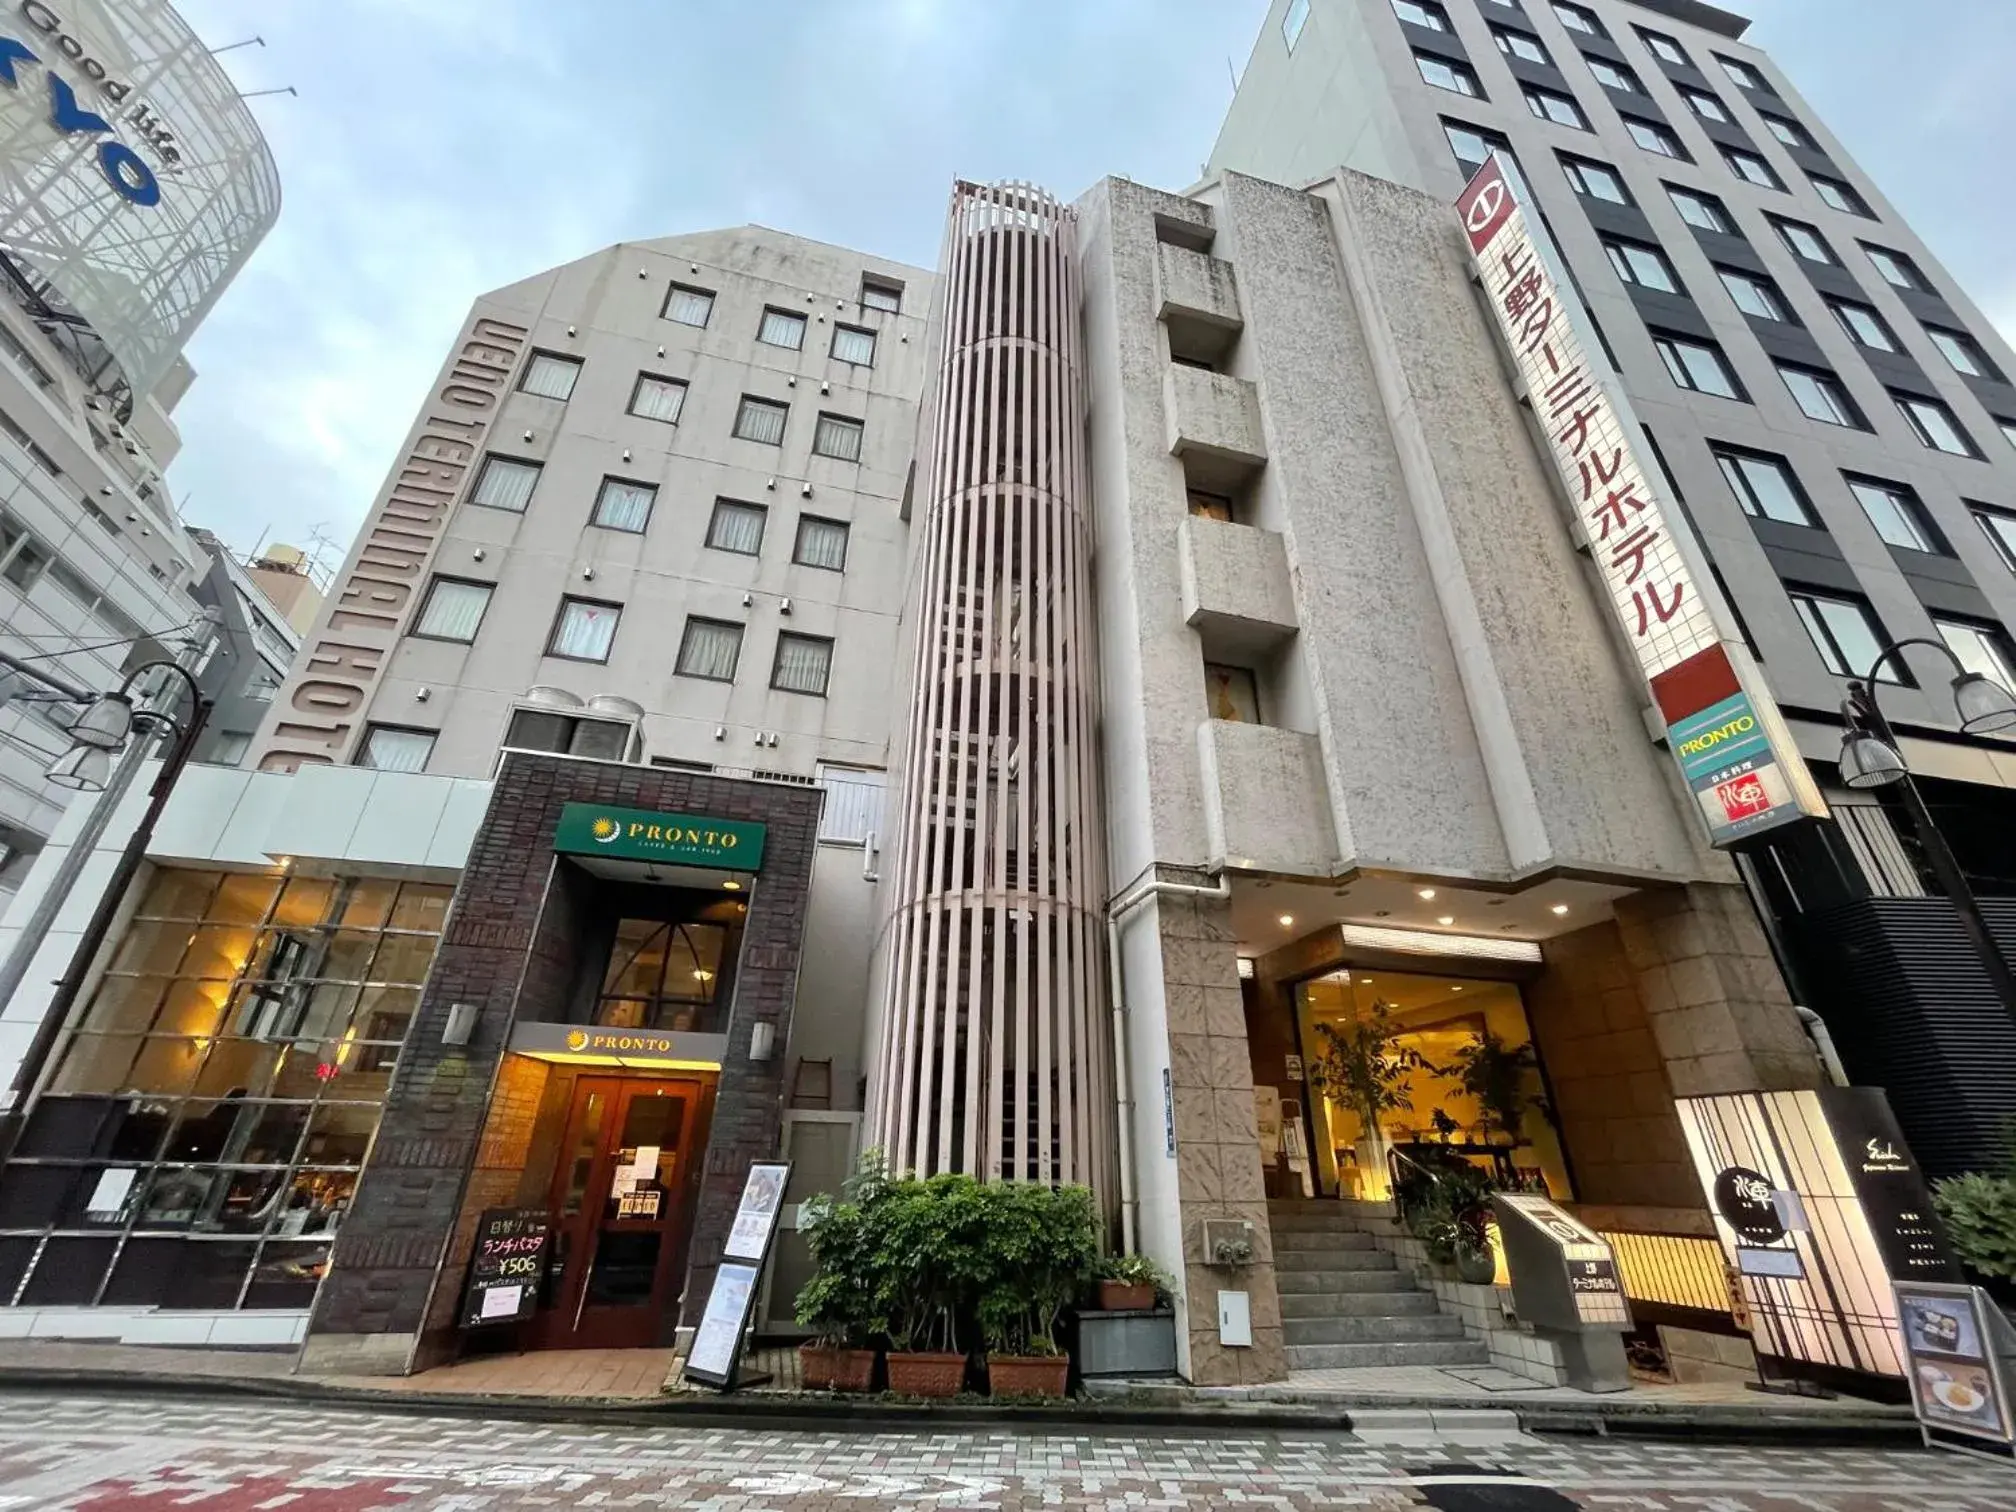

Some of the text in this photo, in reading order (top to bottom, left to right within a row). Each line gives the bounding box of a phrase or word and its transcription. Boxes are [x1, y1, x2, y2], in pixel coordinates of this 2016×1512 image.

[20, 0, 131, 104] Good
[440, 318, 529, 408] UENO
[1498, 242, 1683, 637] 上野ターミナルホテル
[327, 416, 486, 631] TERMINAL
[1678, 715, 1754, 758] PRONTO
[628, 822, 738, 848] PRONTO
[593, 1035, 671, 1052] PRONTO
[483, 1236, 544, 1256] ランチパスタ
[499, 1254, 537, 1275] ¥506
